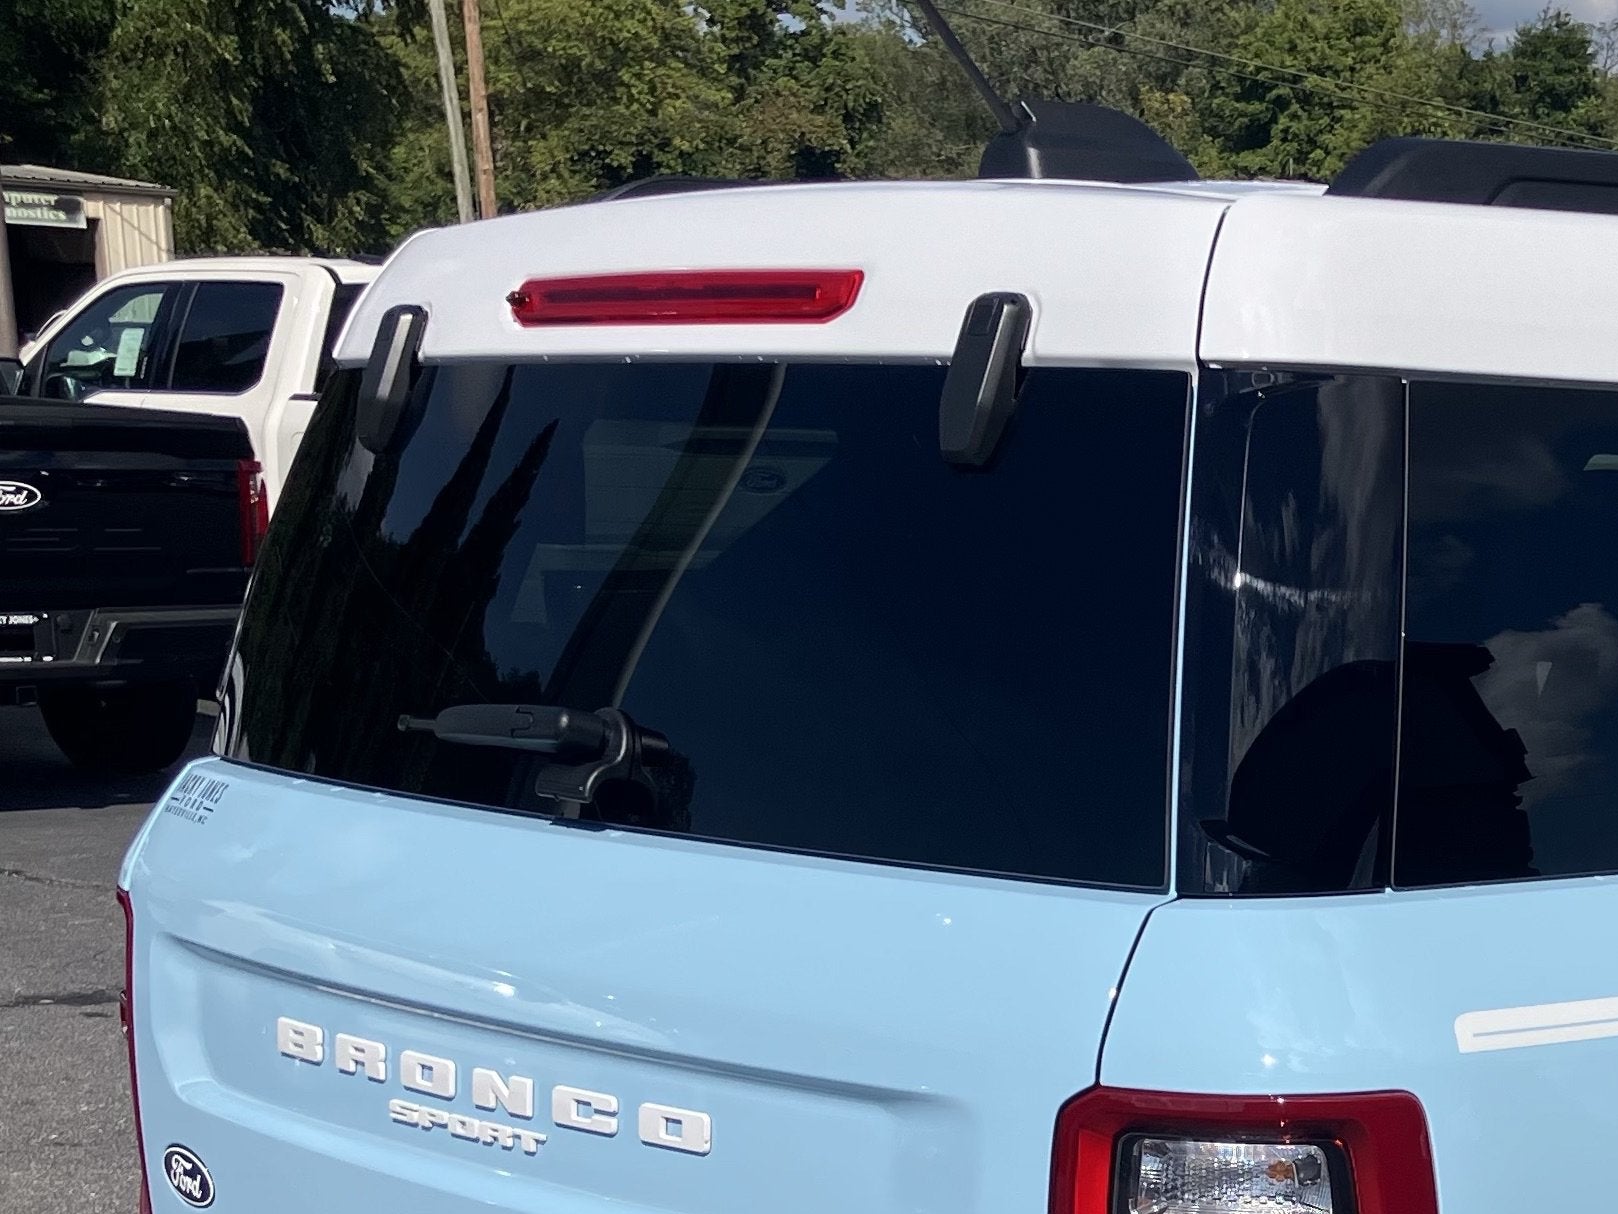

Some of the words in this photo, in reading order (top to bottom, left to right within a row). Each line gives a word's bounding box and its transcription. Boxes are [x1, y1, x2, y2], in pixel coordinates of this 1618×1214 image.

[277, 1016, 712, 1156] BRONCO
[389, 1098, 547, 1155] SPORT
[171, 1154, 203, 1199] Ford
